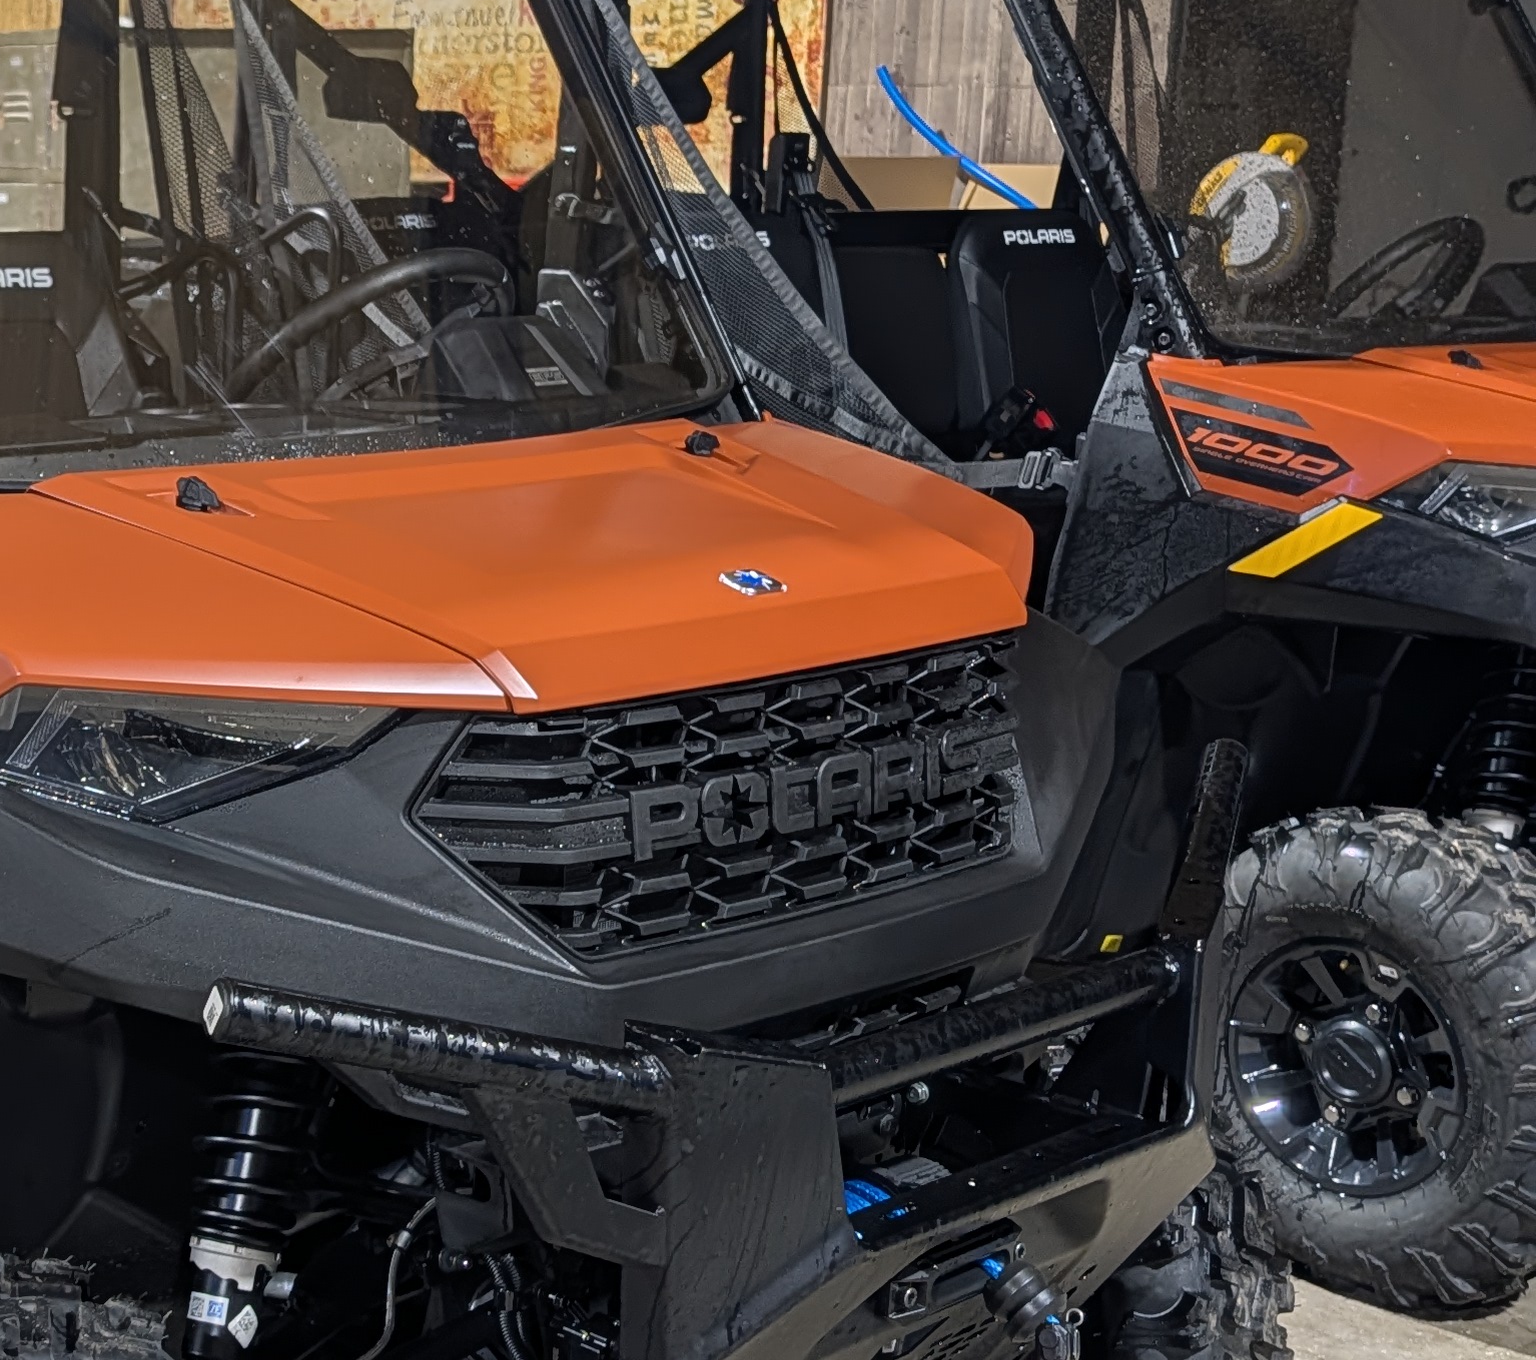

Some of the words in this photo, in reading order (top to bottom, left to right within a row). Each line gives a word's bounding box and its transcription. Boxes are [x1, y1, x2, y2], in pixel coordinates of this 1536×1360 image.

[363, 213, 438, 231] OLARIS
[1004, 228, 1076, 246] POLARIS
[1186, 426, 1340, 477] 1000
[629, 727, 1020, 861] POLARIS
